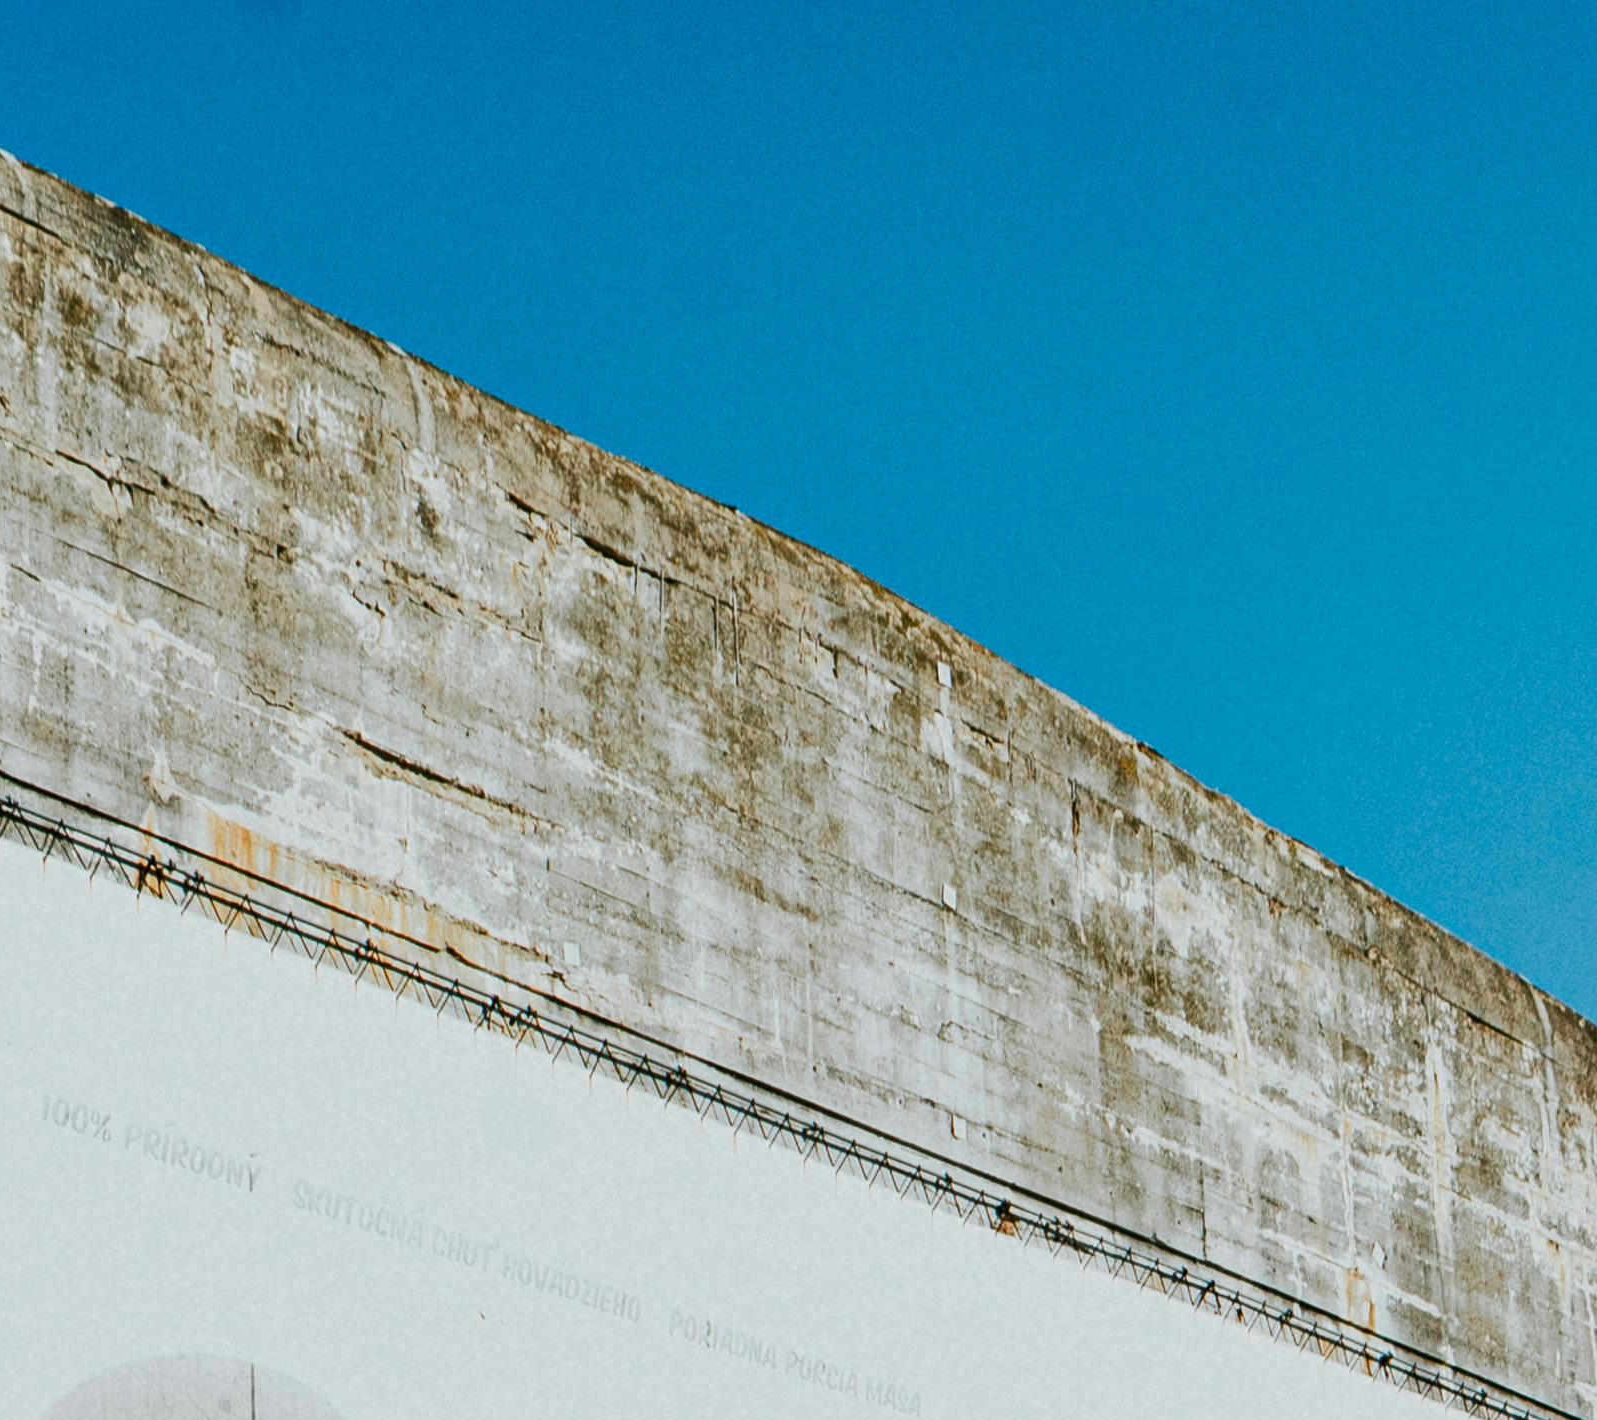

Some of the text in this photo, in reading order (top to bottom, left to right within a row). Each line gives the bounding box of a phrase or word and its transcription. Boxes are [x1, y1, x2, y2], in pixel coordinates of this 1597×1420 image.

[41, 1092, 112, 1143] 100%
[123, 1120, 262, 1193] PRÍRODNÝ
[292, 1177, 425, 1250] SKUTOČNÁ
[668, 1309, 777, 1371] PORIADNA
[784, 1349, 858, 1399] PORCIA
